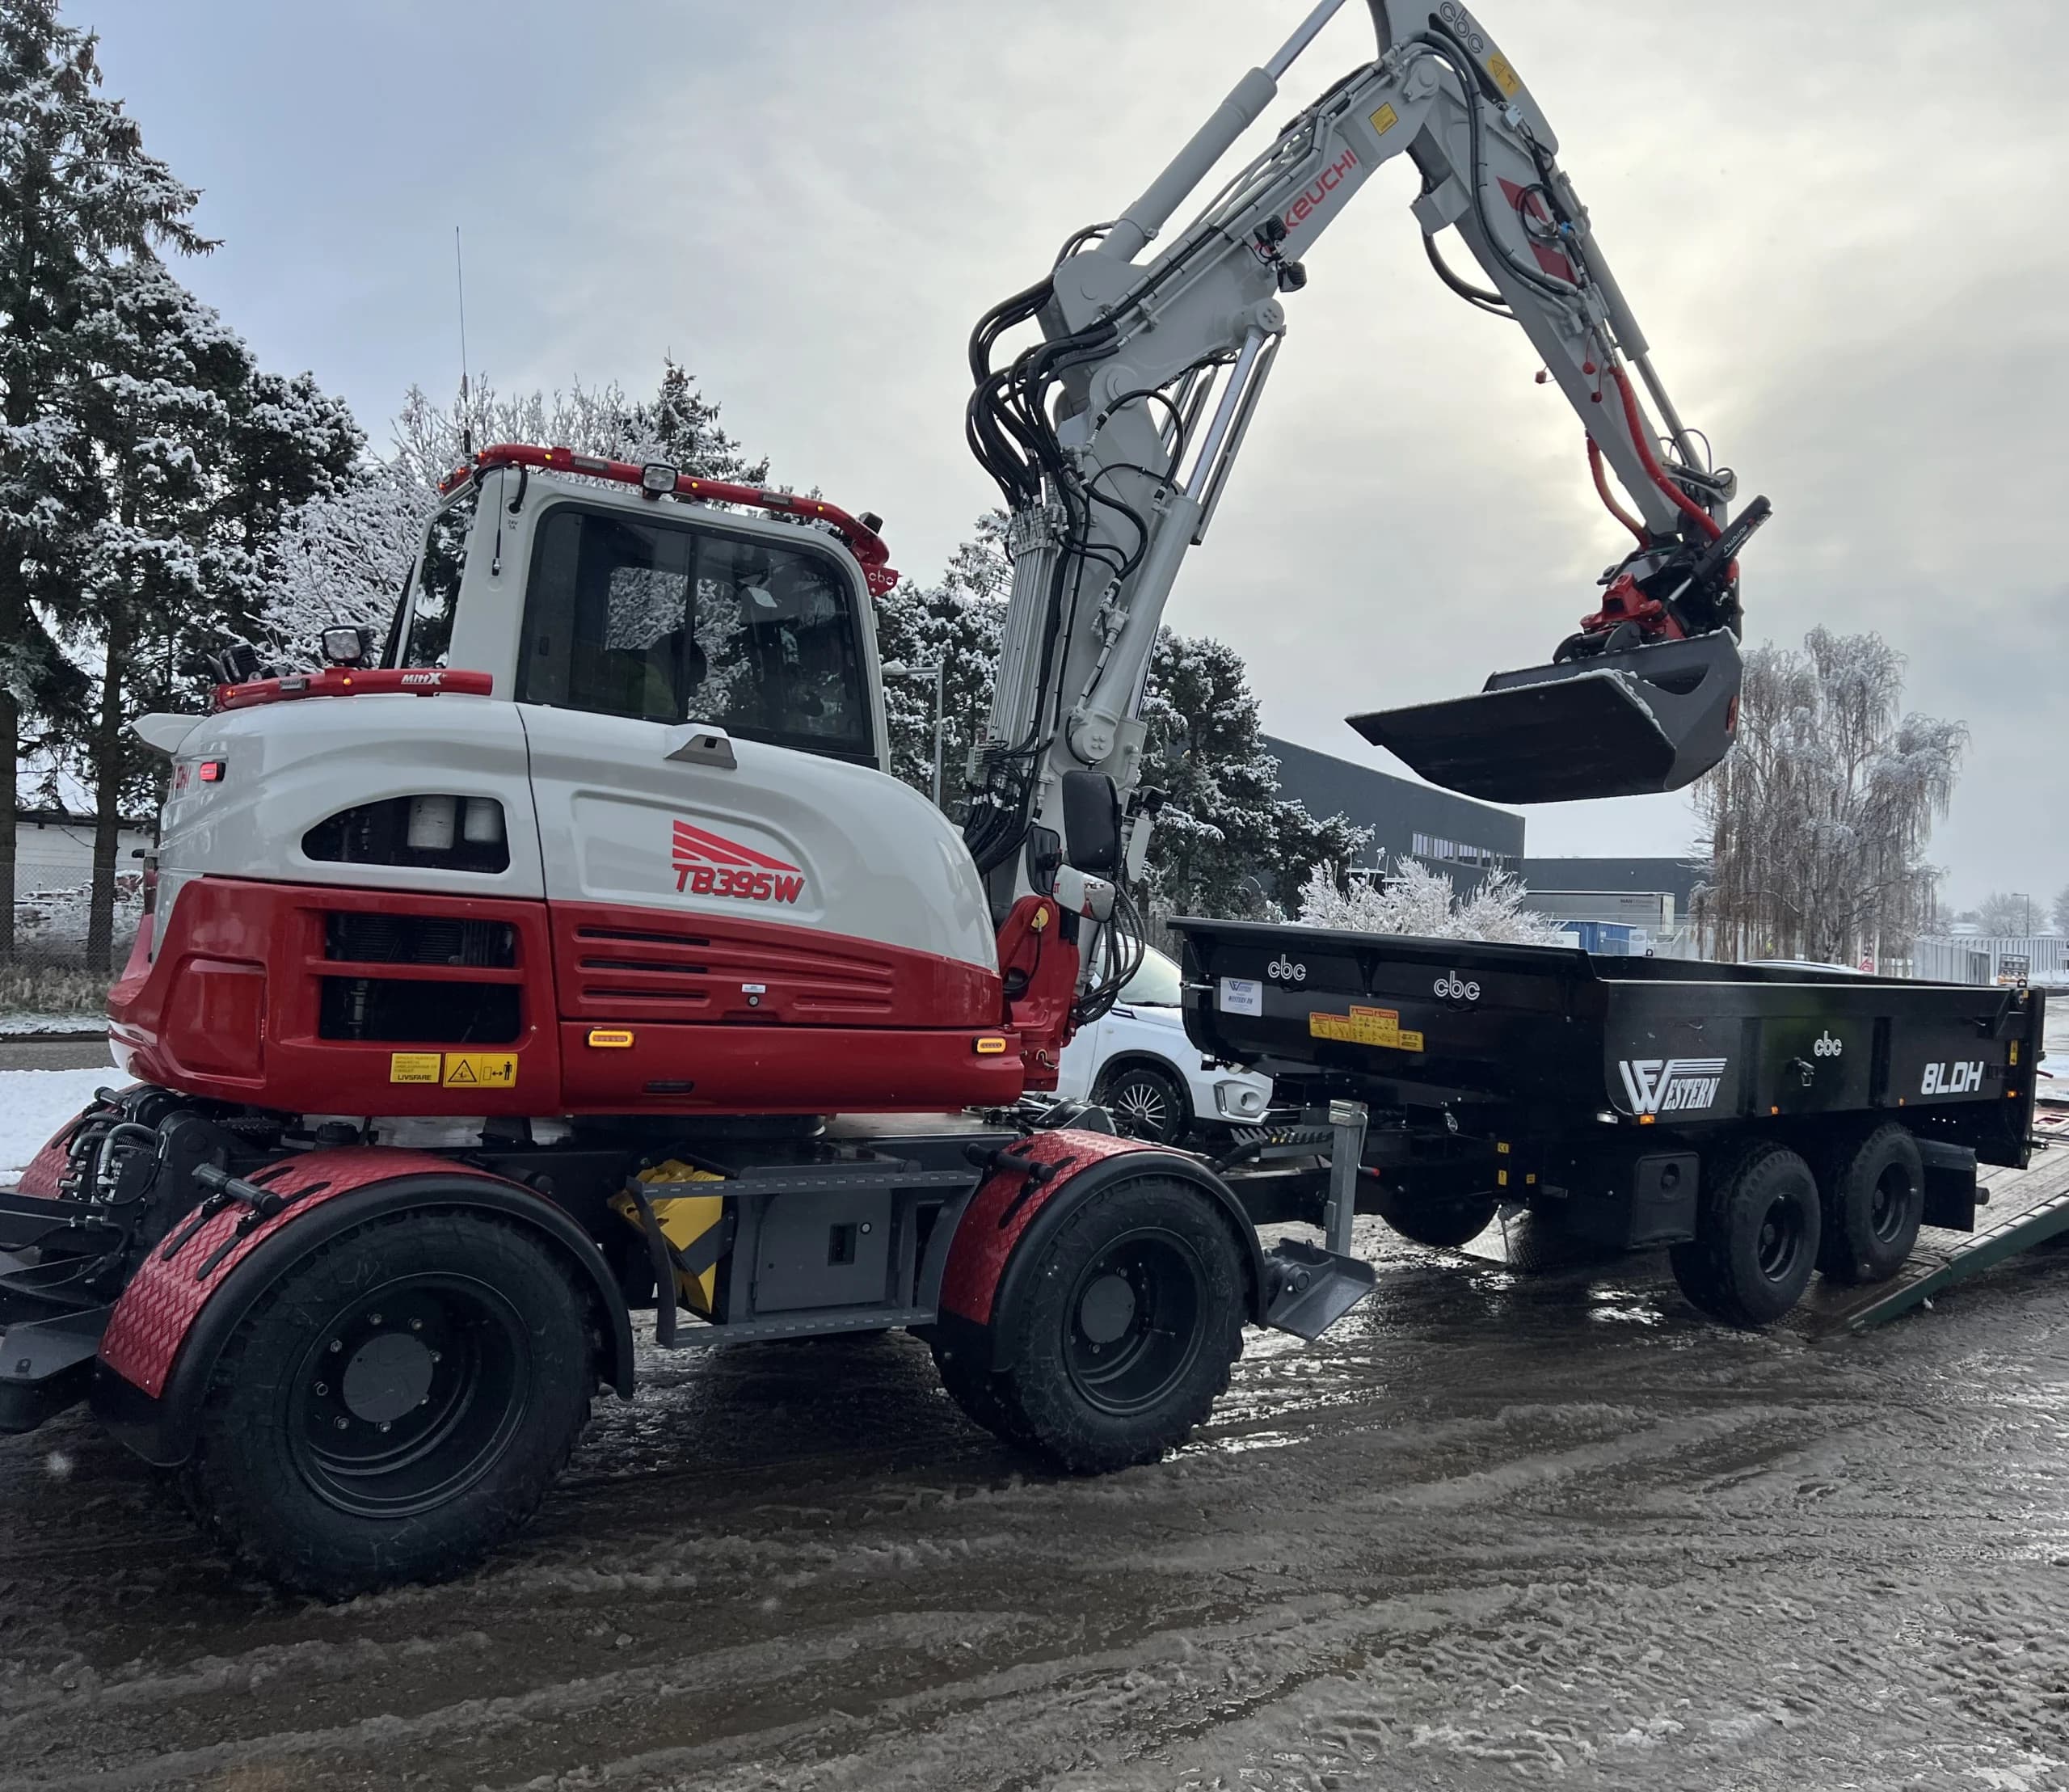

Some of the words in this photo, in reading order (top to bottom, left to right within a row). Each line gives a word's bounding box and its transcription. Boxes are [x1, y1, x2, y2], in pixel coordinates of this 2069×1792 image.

[1439, 2, 1484, 53] cbc
[869, 569, 894, 585] cbc
[672, 863, 805, 904] TB395W
[1268, 954, 1306, 981] cbc
[1434, 970, 1480, 1001] cbc
[1814, 1031, 1842, 1056] cbc
